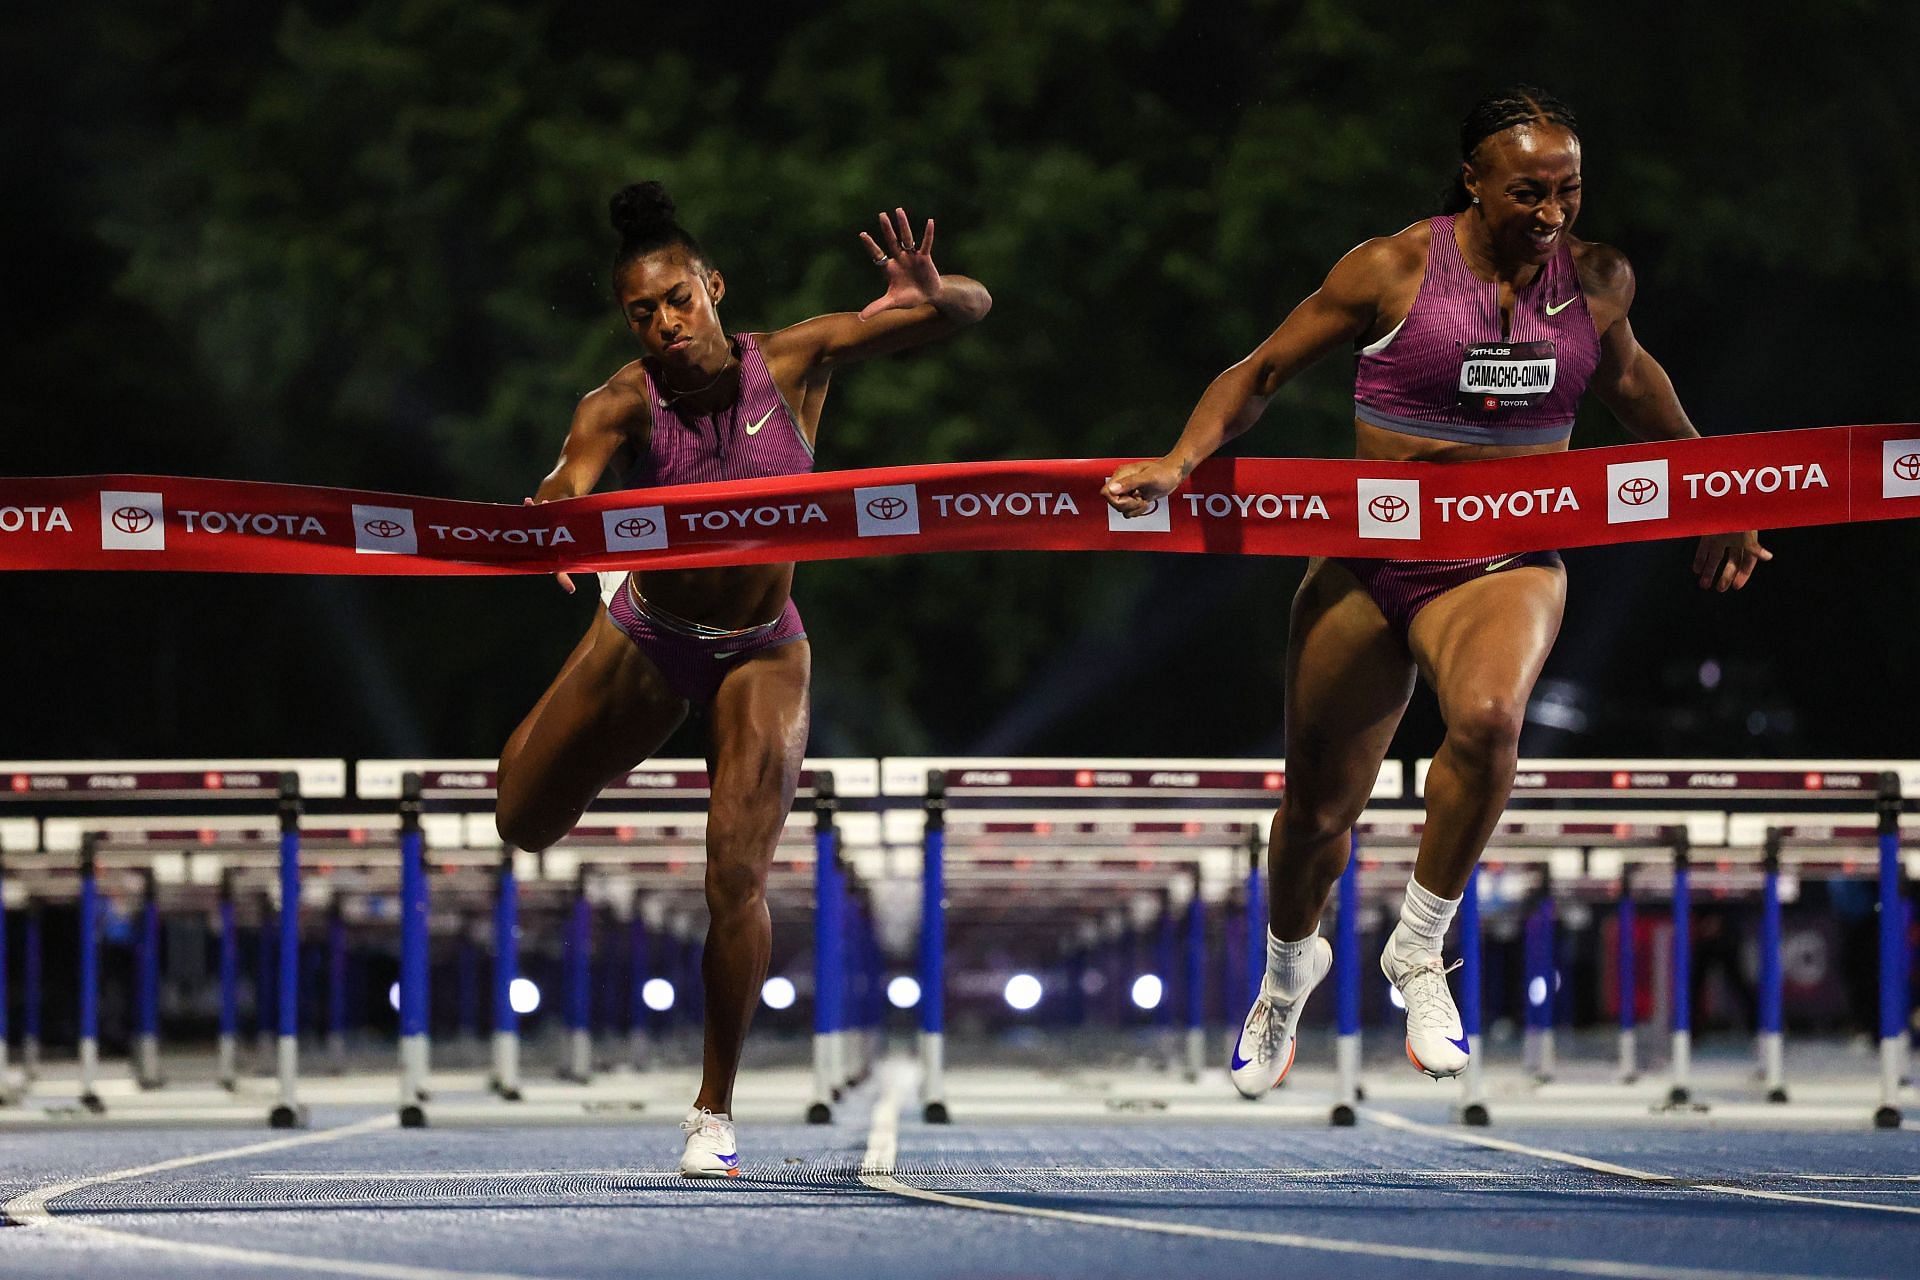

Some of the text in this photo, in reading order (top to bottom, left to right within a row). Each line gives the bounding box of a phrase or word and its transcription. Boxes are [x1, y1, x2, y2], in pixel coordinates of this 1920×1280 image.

[1470, 347, 1511, 357] ATHLOS
[1467, 364, 1550, 388] CAMACHO-QUINN
[178, 509, 326, 535] TOYOTA
[428, 525, 576, 546] TOYOTA
[680, 502, 828, 531] TOYOTA
[931, 492, 1080, 517] TOYOTA
[1182, 493, 1331, 520] TOYOTA
[1434, 486, 1580, 523] TOYOTA
[1682, 463, 1829, 499] TOYOTA
